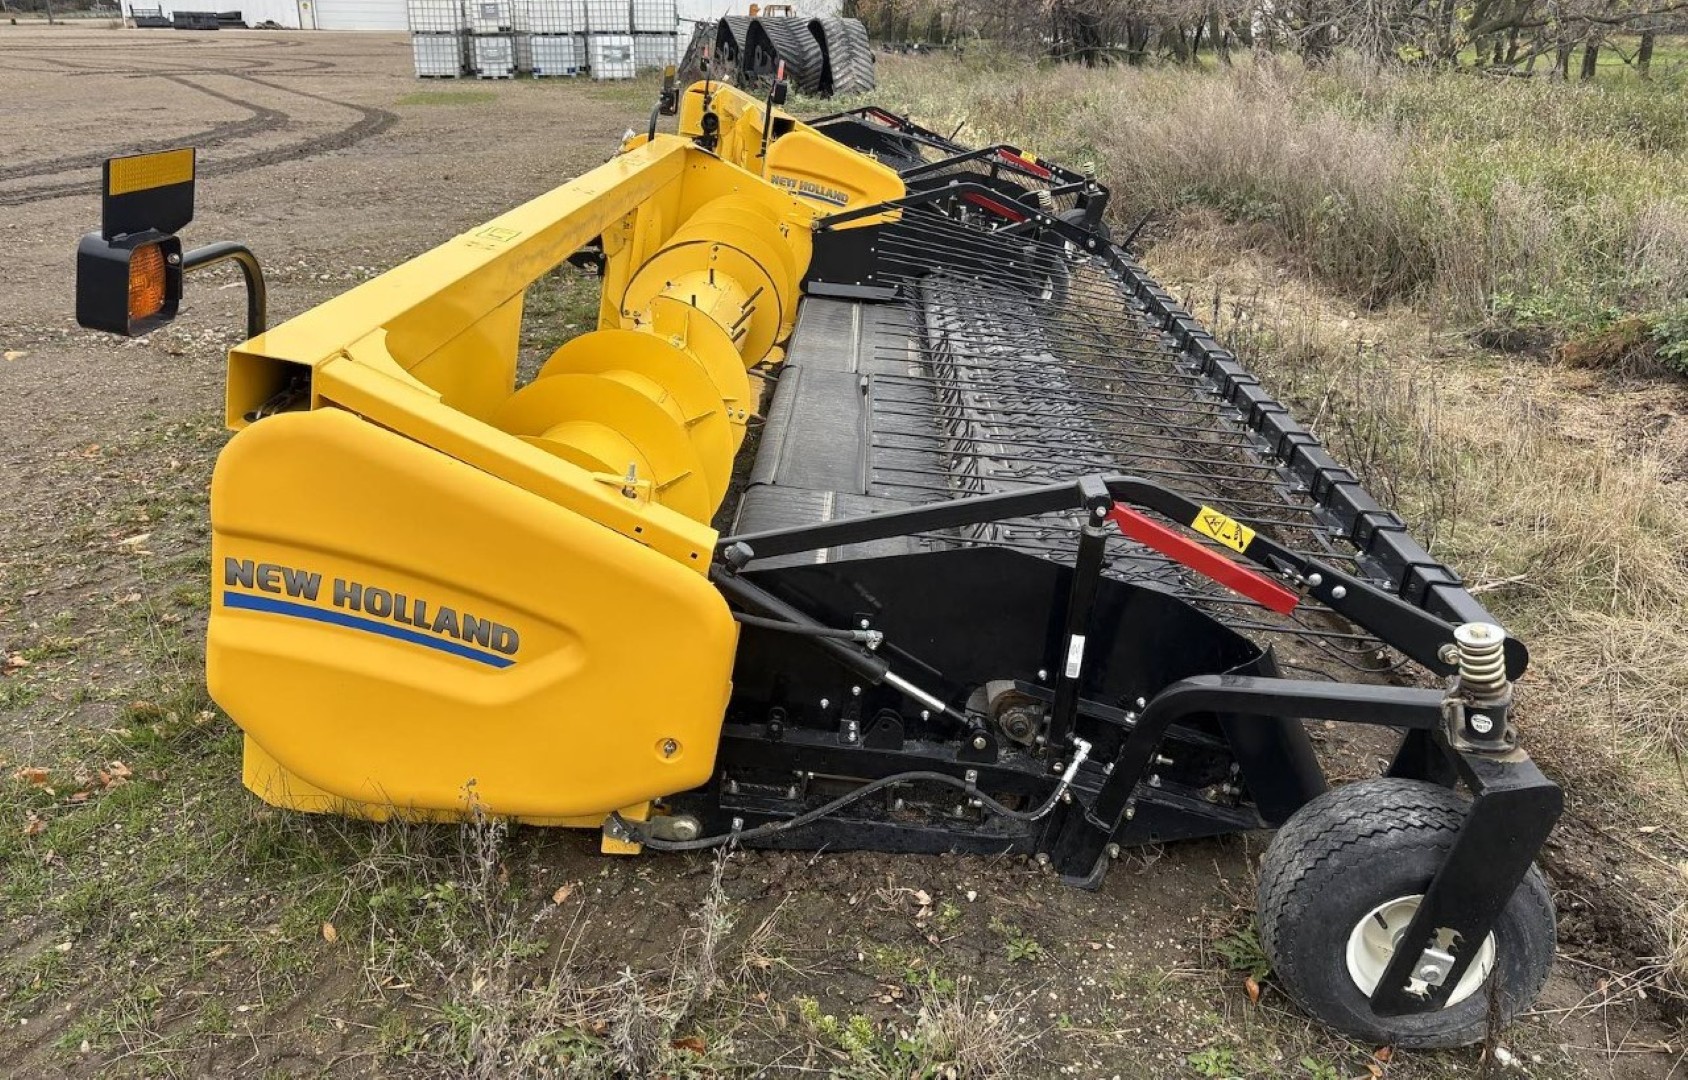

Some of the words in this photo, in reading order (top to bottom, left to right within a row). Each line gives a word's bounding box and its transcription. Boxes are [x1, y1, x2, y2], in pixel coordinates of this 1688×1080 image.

[771, 175, 797, 188] NEW
[799, 180, 849, 202] HOLLAND
[224, 557, 321, 600] NEW
[333, 578, 519, 654] HOLLAND
